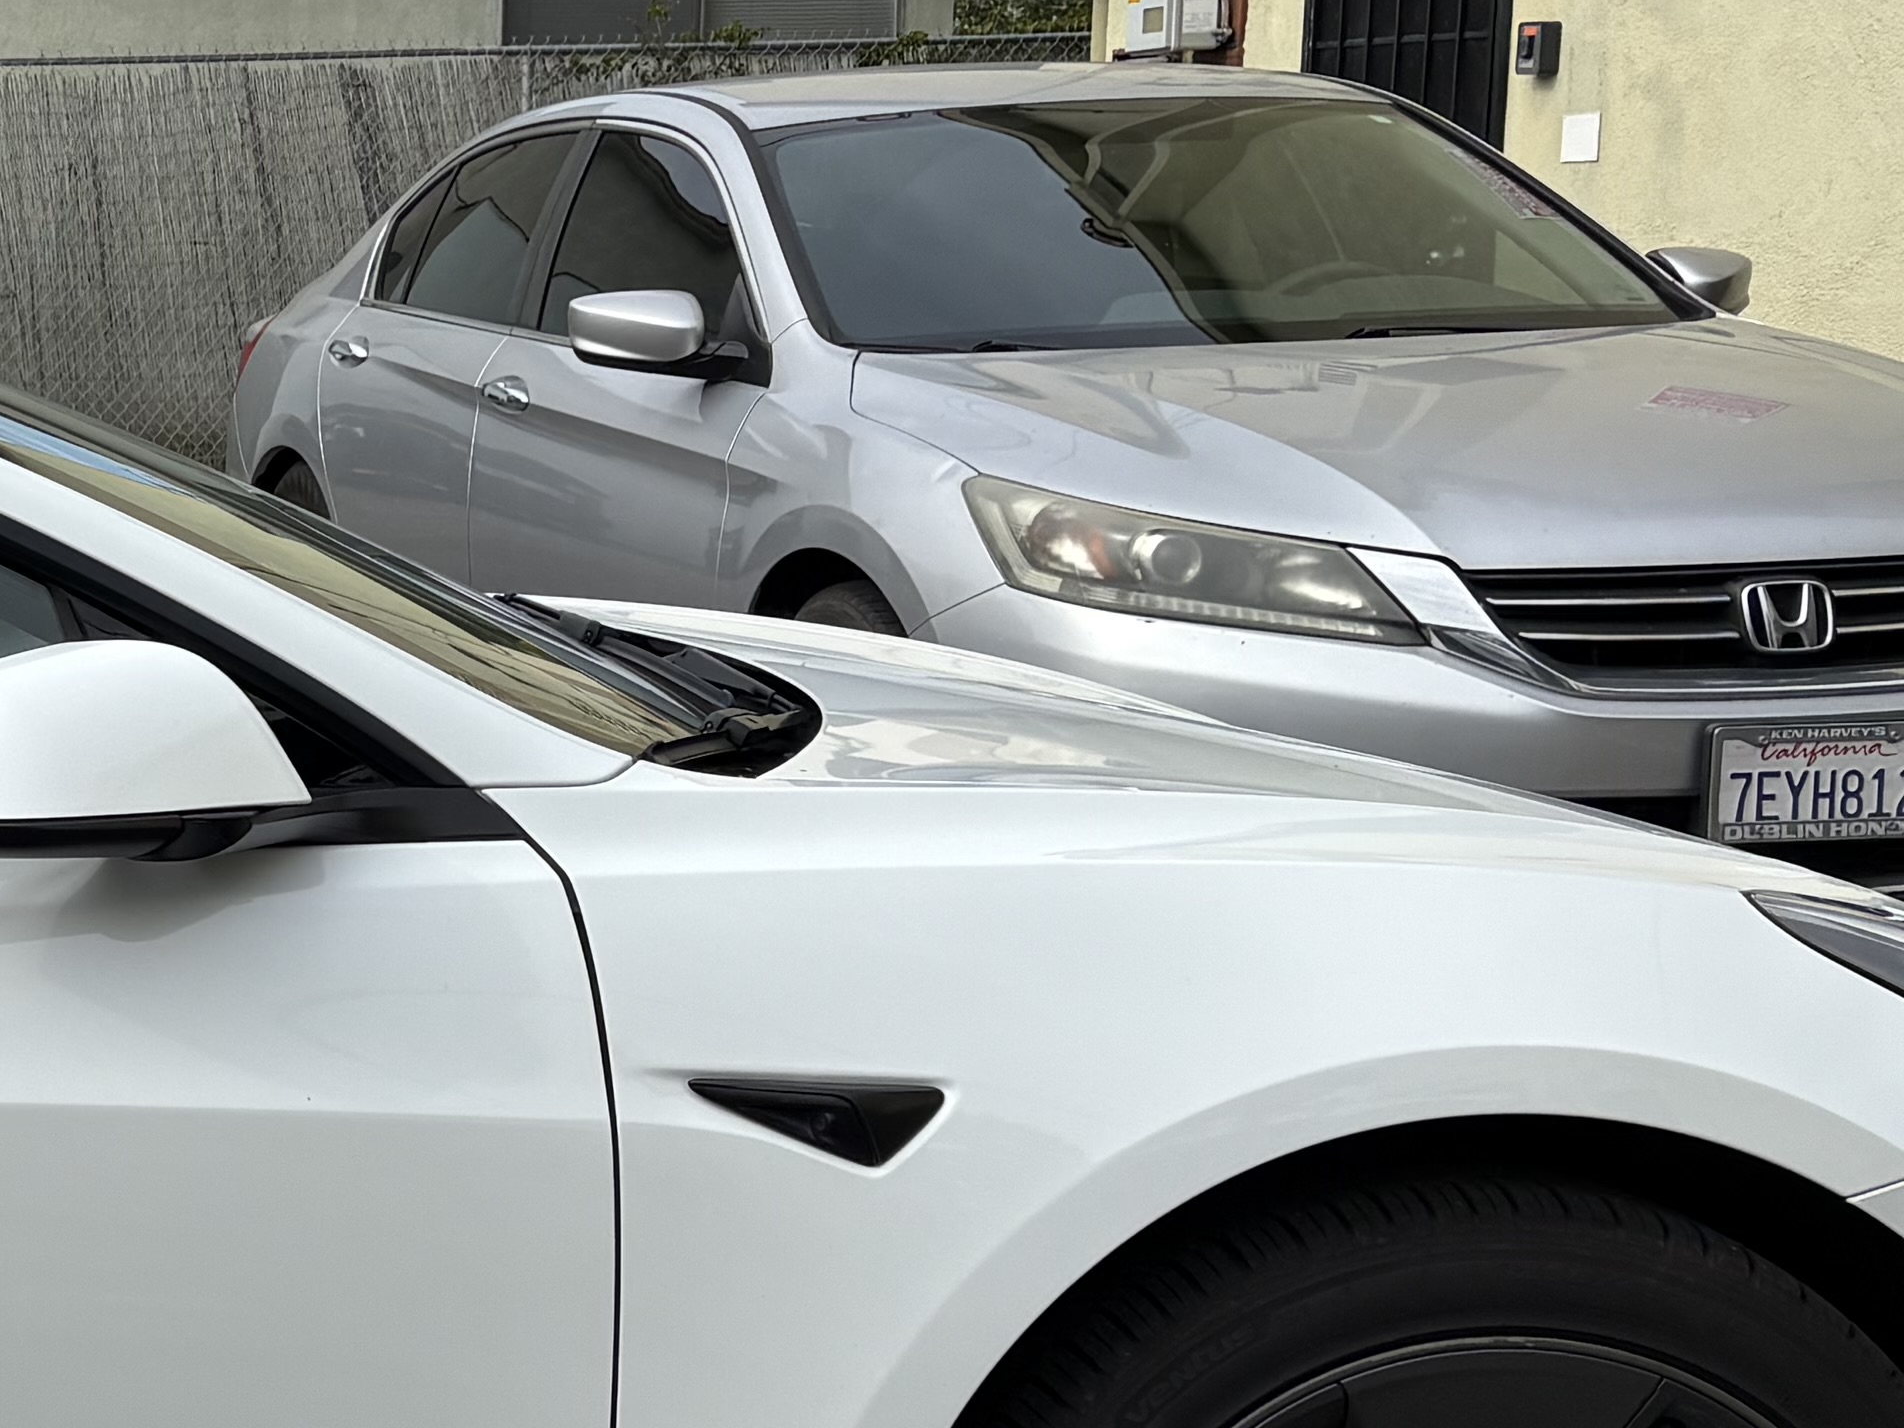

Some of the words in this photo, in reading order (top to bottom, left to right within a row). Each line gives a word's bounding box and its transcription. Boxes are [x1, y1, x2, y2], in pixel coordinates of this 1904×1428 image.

[1771, 728, 1804, 739] KEN
[1807, 726, 1887, 738] HARVEY'S
[1760, 740, 1898, 767] California
[1724, 822, 1824, 841] DUBLIN
